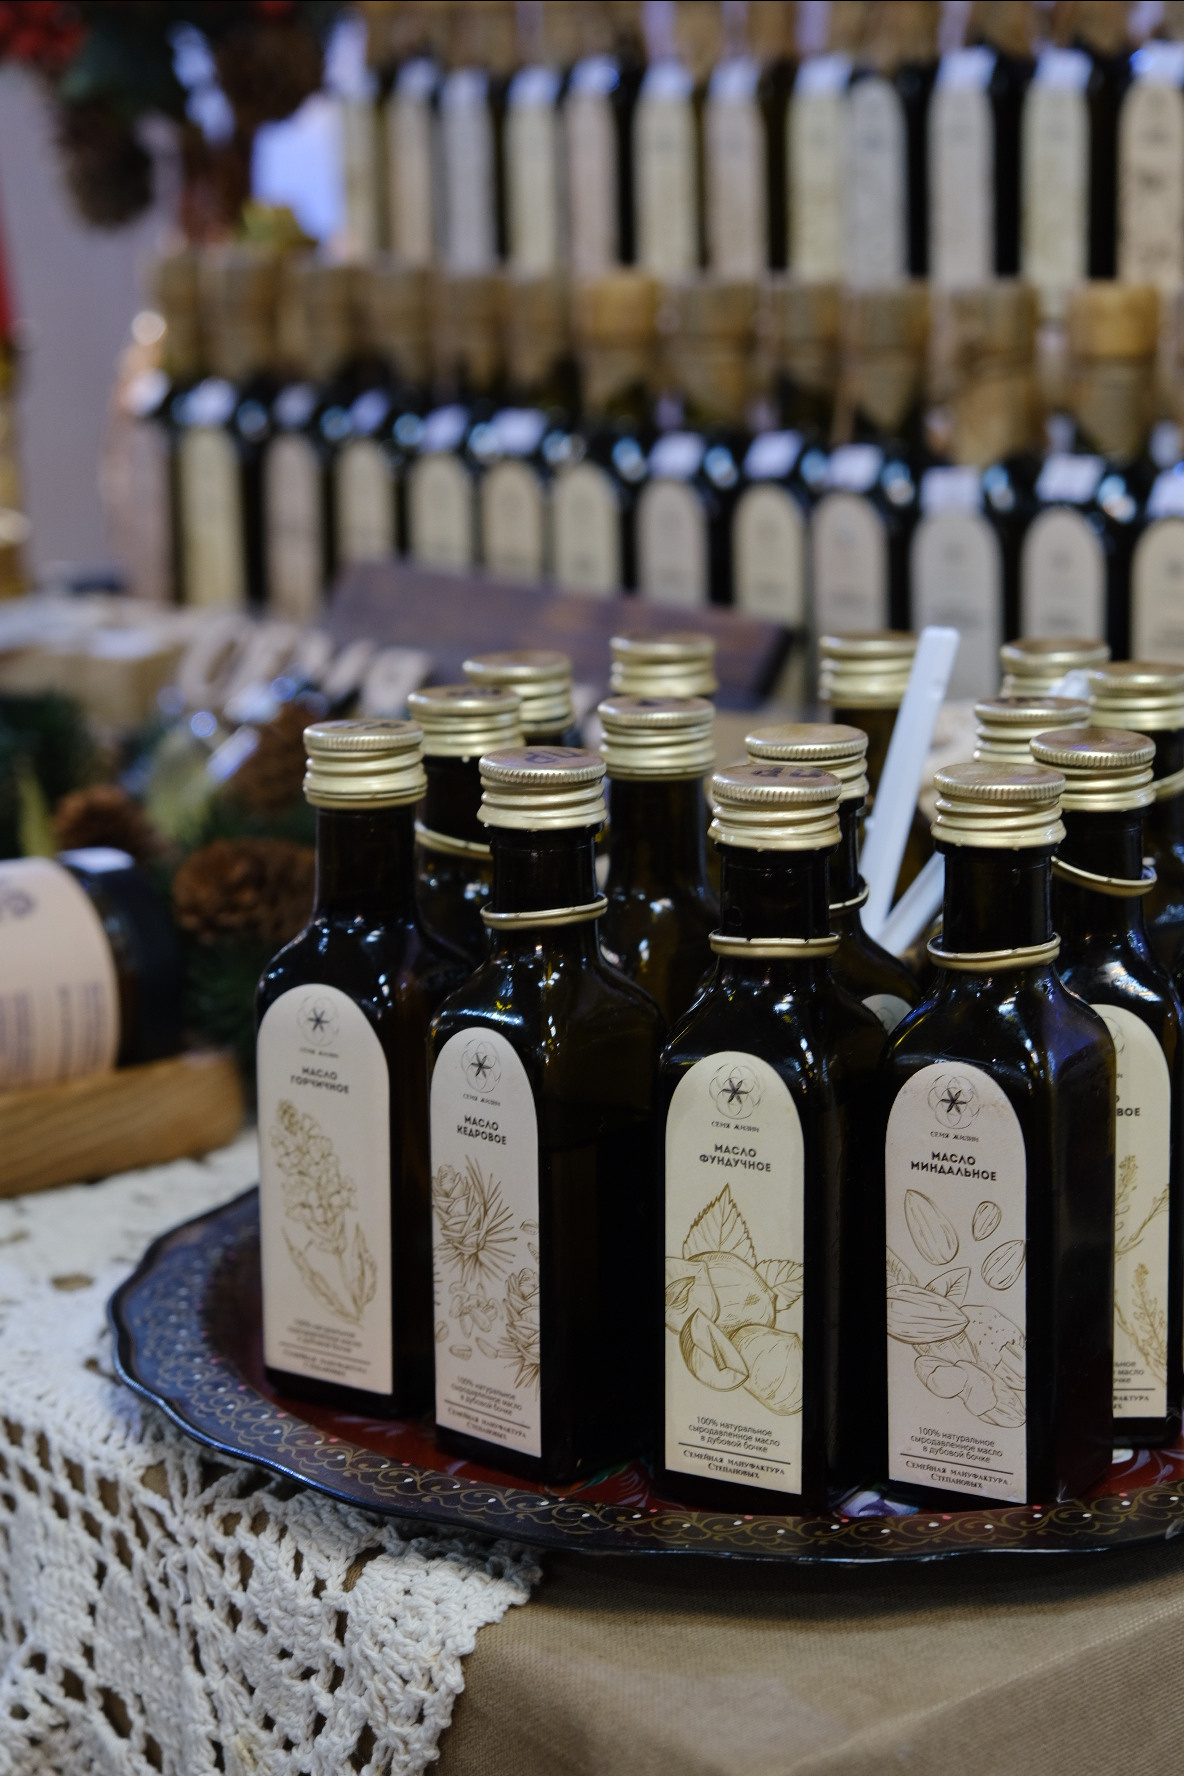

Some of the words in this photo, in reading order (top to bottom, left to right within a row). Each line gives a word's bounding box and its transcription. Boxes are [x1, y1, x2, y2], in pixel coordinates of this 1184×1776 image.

[302, 1067, 338, 1081] МАСЛО
[464, 1115, 499, 1131] МАСЛО
[457, 1125, 507, 1145] КЕДРОВОЕ
[715, 1144, 756, 1158] МАСЛО
[932, 1151, 976, 1165] МАСЛО
[700, 1154, 771, 1172] ФУНДУЧНОЕ
[911, 1160, 996, 1181] МИНДАЛЬНОЕ
[697, 1416, 718, 1428] 100%
[720, 1422, 772, 1437] натуральное
[707, 1437, 742, 1449] дубовой
[743, 1443, 768, 1454] бочке
[755, 1437, 780, 1447] масло
[919, 1426, 940, 1438] 100%
[942, 1432, 995, 1448] натуральное
[910, 1435, 975, 1453] сыродавленное
[977, 1447, 1003, 1458] масло
[929, 1447, 965, 1460] дубовой
[966, 1452, 991, 1464] бочке
